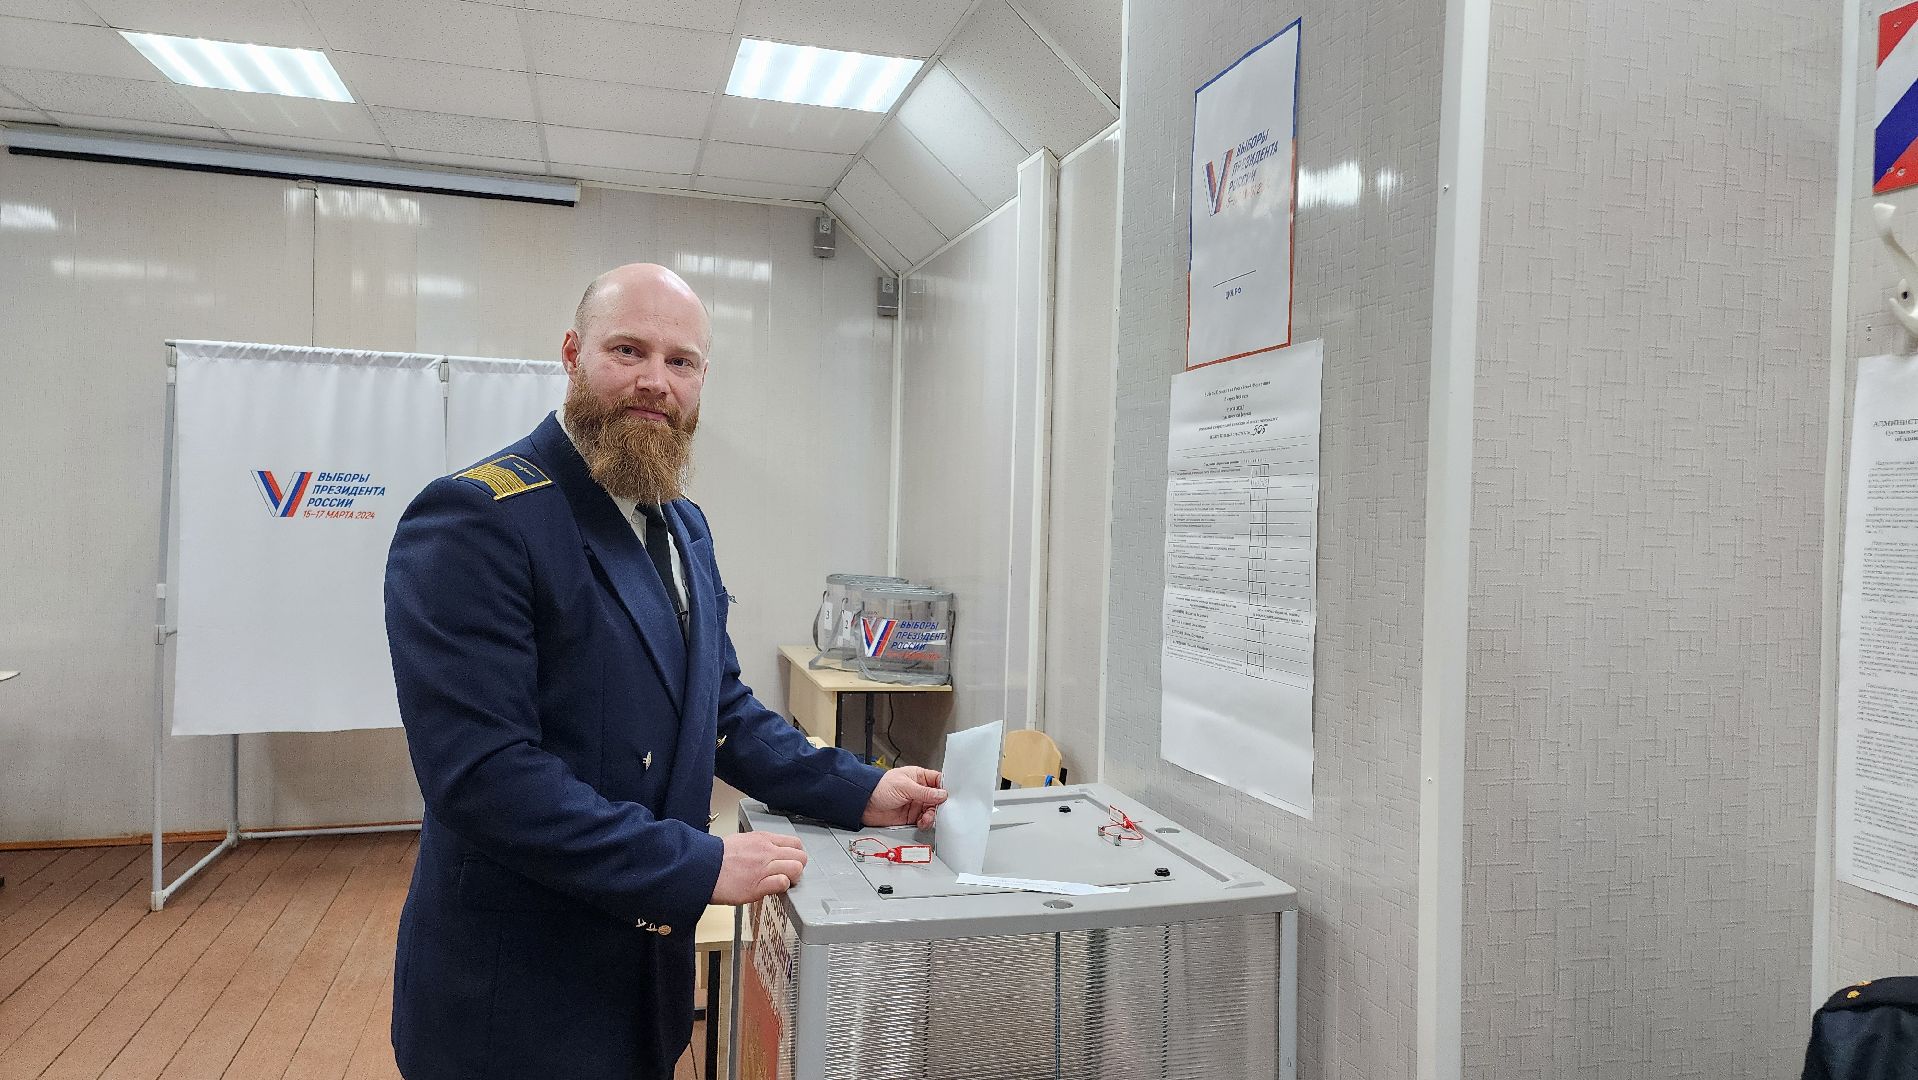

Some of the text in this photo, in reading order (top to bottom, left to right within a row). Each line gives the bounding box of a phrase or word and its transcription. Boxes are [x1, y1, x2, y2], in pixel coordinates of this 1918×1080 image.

[317, 472, 370, 483] ВЫБОРЫ
[312, 485, 386, 496] ПРЕЗИДЕНТА
[307, 498, 354, 508] РОССИИ
[326, 511, 354, 519] МАРТА
[355, 511, 375, 520] 2024
[900, 620, 939, 630] ВЫБОРЫ
